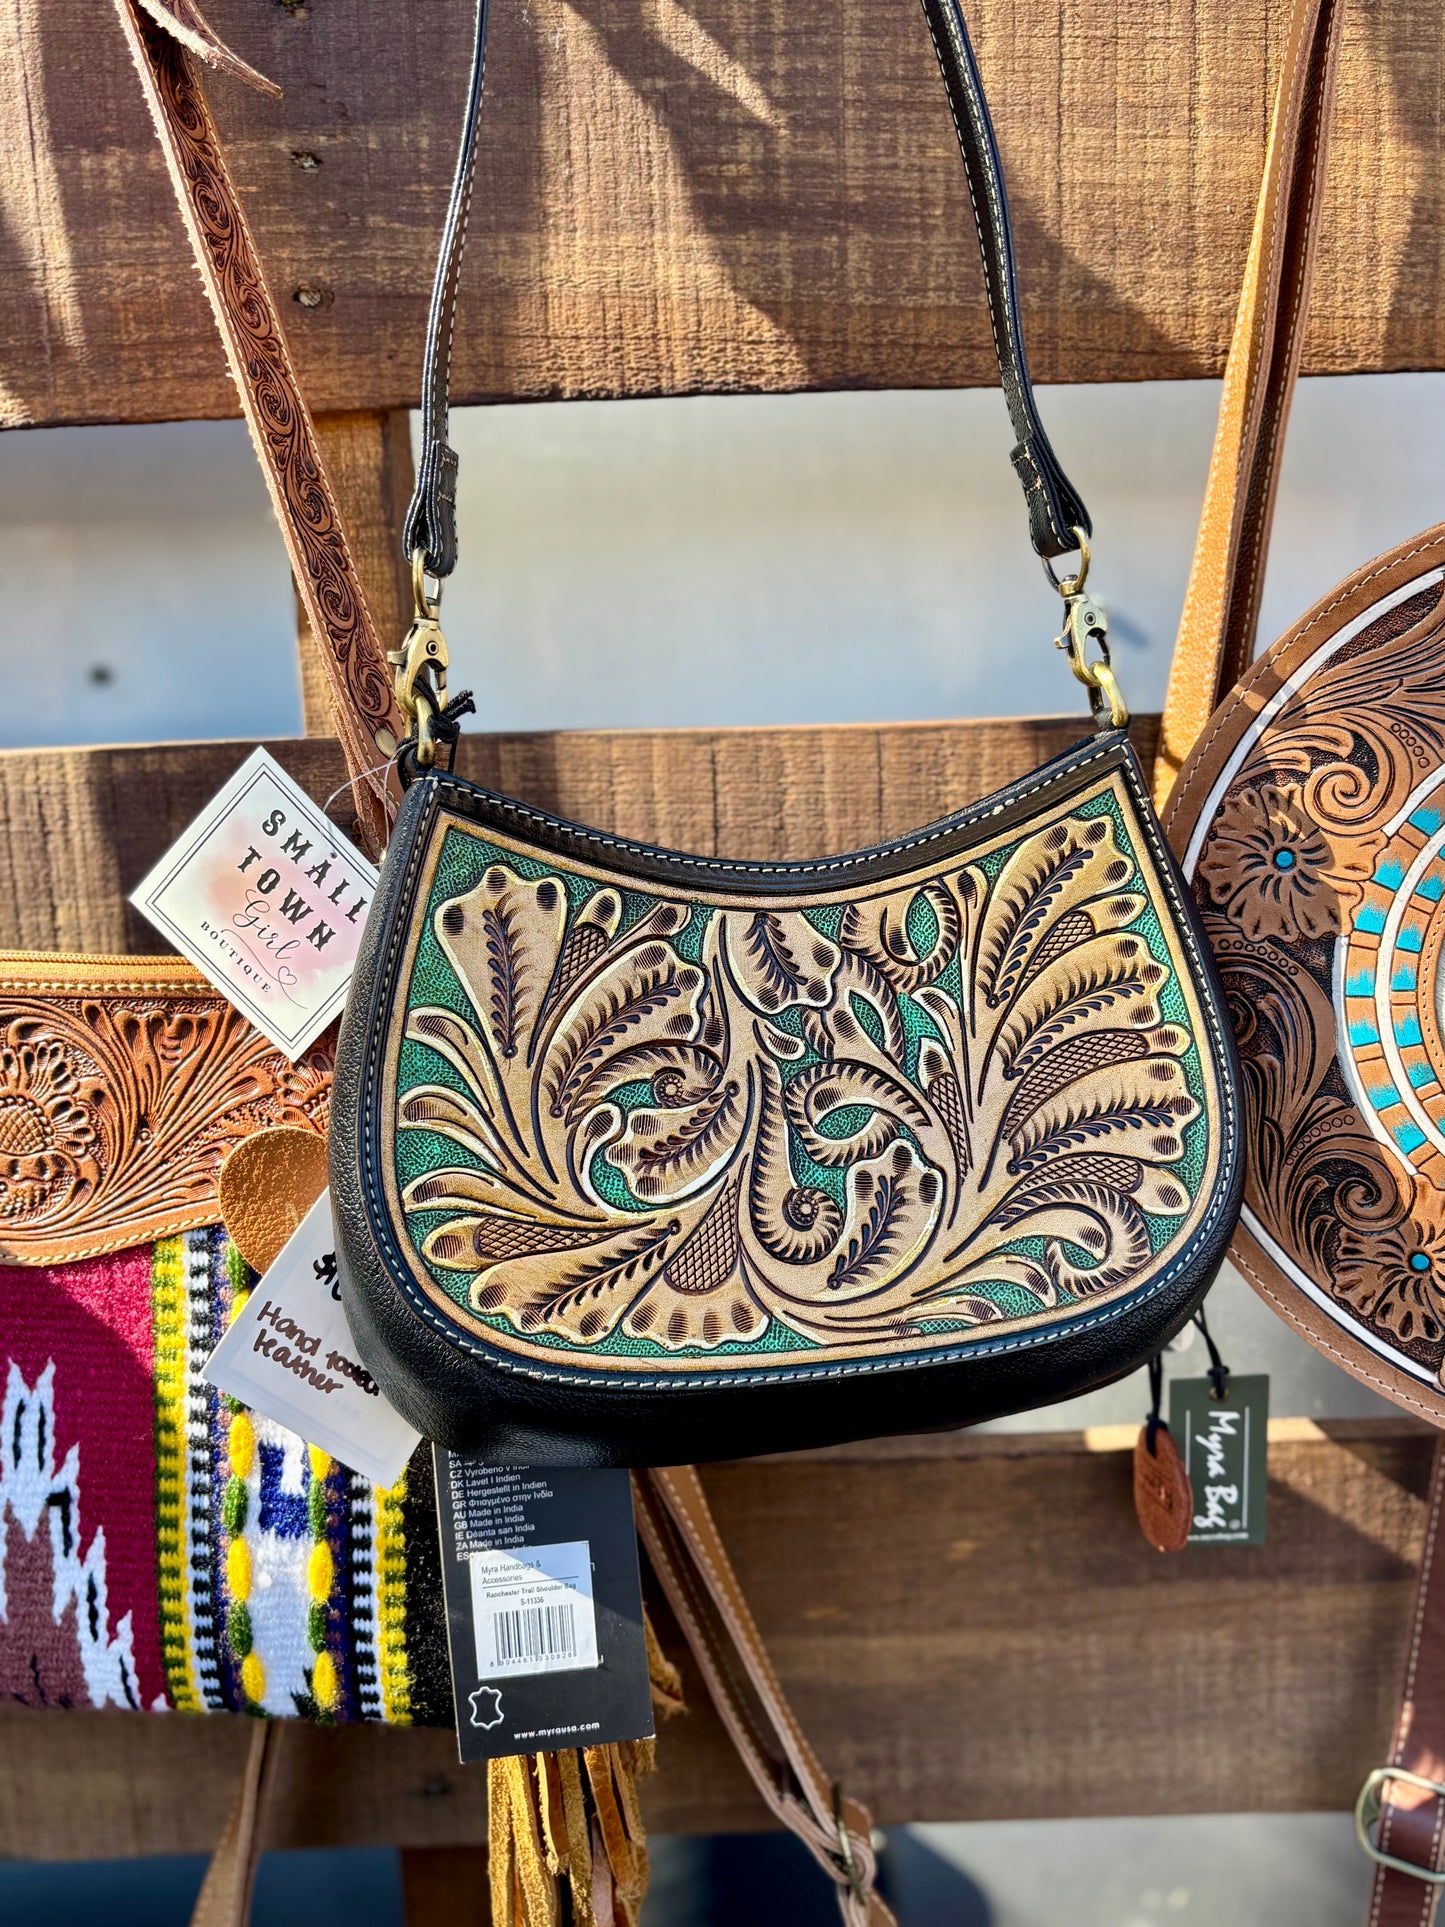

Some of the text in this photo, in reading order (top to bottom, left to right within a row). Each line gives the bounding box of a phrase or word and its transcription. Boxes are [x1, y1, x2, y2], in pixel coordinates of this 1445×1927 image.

[261, 809, 368, 923] SMALL
[237, 846, 336, 951] TOWN
[232, 889, 301, 959] Girl
[200, 921, 271, 993] BOUTIQUE
[257, 1301, 322, 1355] Hand
[253, 1329, 344, 1393] leather
[1195, 1411, 1240, 1478] Myra
[449, 1460, 462, 1469] SA
[450, 1470, 462, 1478] CZ
[465, 1466, 503, 1477] Vyrobeno
[451, 1480, 464, 1489] DK
[466, 1477, 488, 1487] Lavet
[496, 1474, 520, 1483] Indien
[452, 1491, 464, 1499] DE
[467, 1485, 510, 1497] Hergestellt
[522, 1481, 547, 1490] Indien
[452, 1501, 467, 1510] GR
[453, 1504, 523, 1520] AU Made in India
[1193, 1484, 1238, 1528] Bag
[454, 1521, 468, 1530] GB
[470, 1518, 493, 1528] Made
[504, 1514, 524, 1523] India
[455, 1532, 464, 1540] IE
[498, 1527, 513, 1535] san
[515, 1523, 535, 1532] India
[456, 1542, 468, 1551] ZA
[470, 1539, 492, 1548] Made
[504, 1535, 525, 1543] India
[456, 1553, 469, 1561] ES
[481, 1560, 541, 1575] Myra Handbags &
[482, 1575, 522, 1585] Accessories
[486, 1589, 520, 1598] Ranchester
[537, 1584, 563, 1593] Shoulder
[514, 1722, 600, 1740] www.myrausa.com
